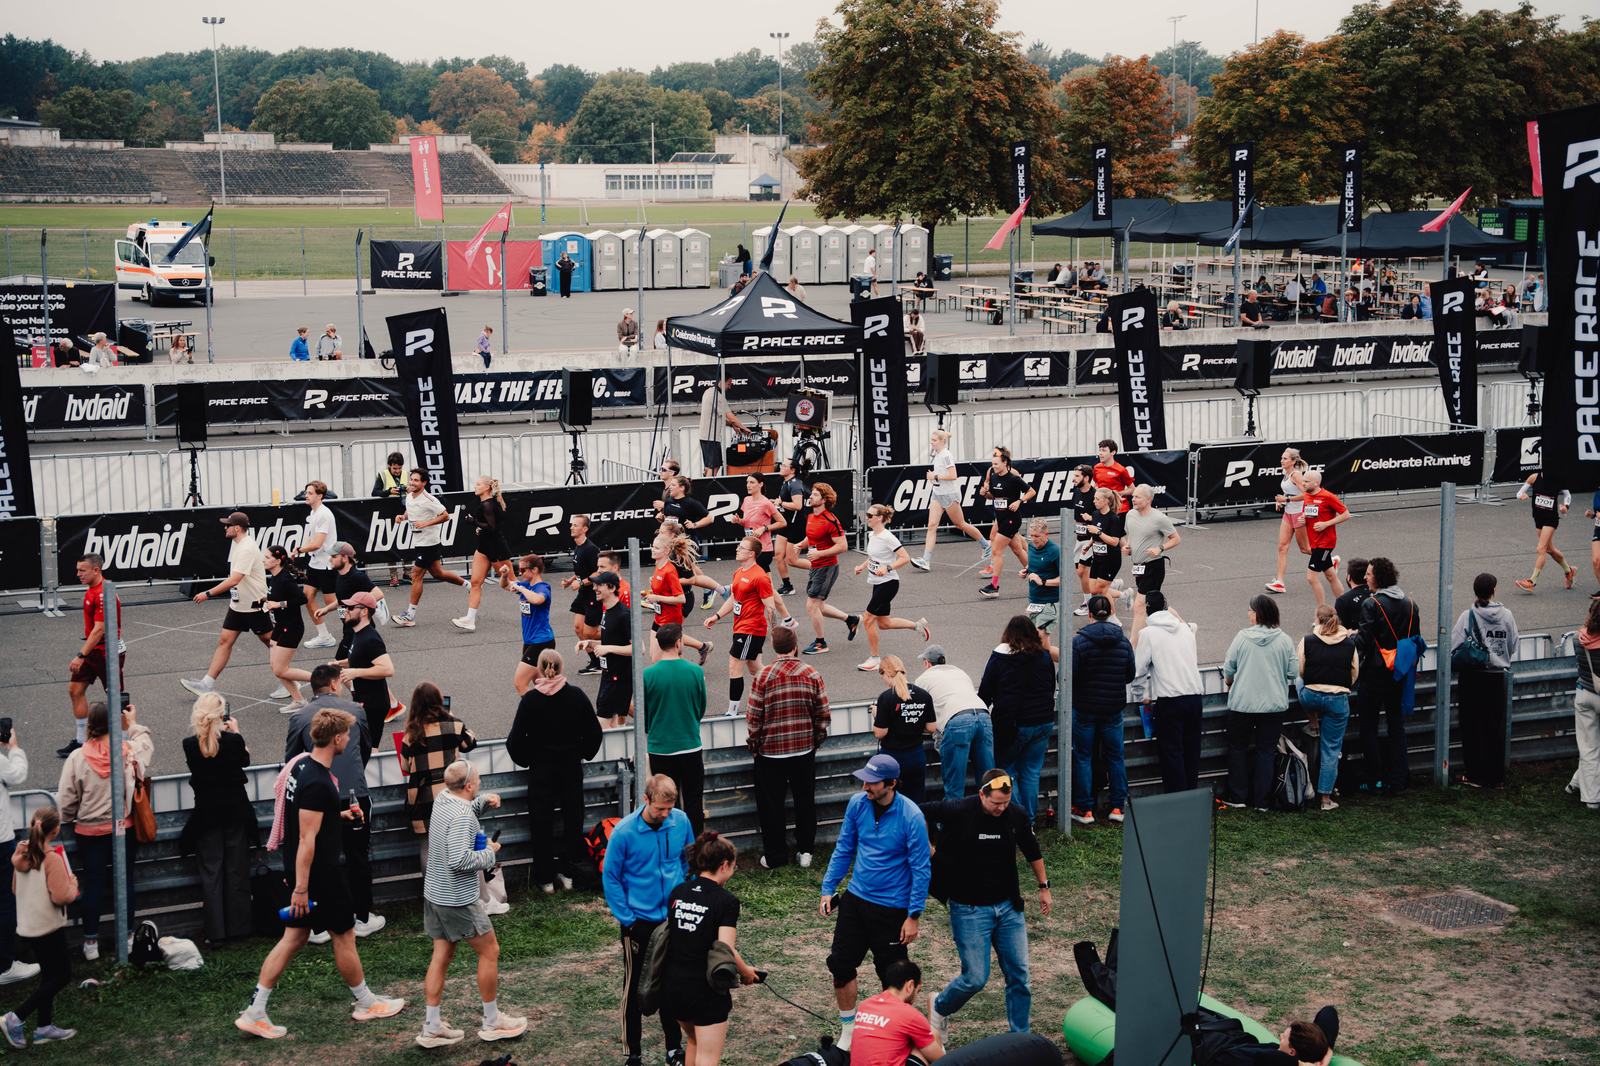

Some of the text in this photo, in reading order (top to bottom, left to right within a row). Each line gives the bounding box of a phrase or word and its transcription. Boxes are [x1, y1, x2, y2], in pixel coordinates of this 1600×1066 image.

[381, 270, 432, 279] PACE RACE
[760, 336, 803, 347] PACE
[803, 335, 846, 346] RACE
[1574, 230, 1600, 461] PACE RACE
[1274, 345, 1318, 369] hydraid
[1332, 342, 1376, 366] hydraid
[698, 379, 717, 387] PAC
[831, 374, 849, 384] Lap
[869, 358, 889, 415] RACE
[331, 394, 360, 402] PACE
[361, 393, 390, 401] RACE
[454, 381, 495, 404] HASE
[498, 380, 534, 402] THE
[1128, 350, 1153, 448] ACE RACE
[64, 392, 131, 422] hydraid
[208, 398, 238, 406] PACE
[417, 376, 440, 436] RACE
[1361, 453, 1471, 471] Celebrate Running
[613, 508, 655, 522] RACE
[900, 702, 926, 710] Faster
[901, 709, 924, 717] Every
[905, 716, 919, 724] Lap
[675, 899, 709, 914] Faster
[674, 908, 704, 924] Every
[677, 919, 697, 932] Lap
[855, 1011, 890, 1028] CREW
